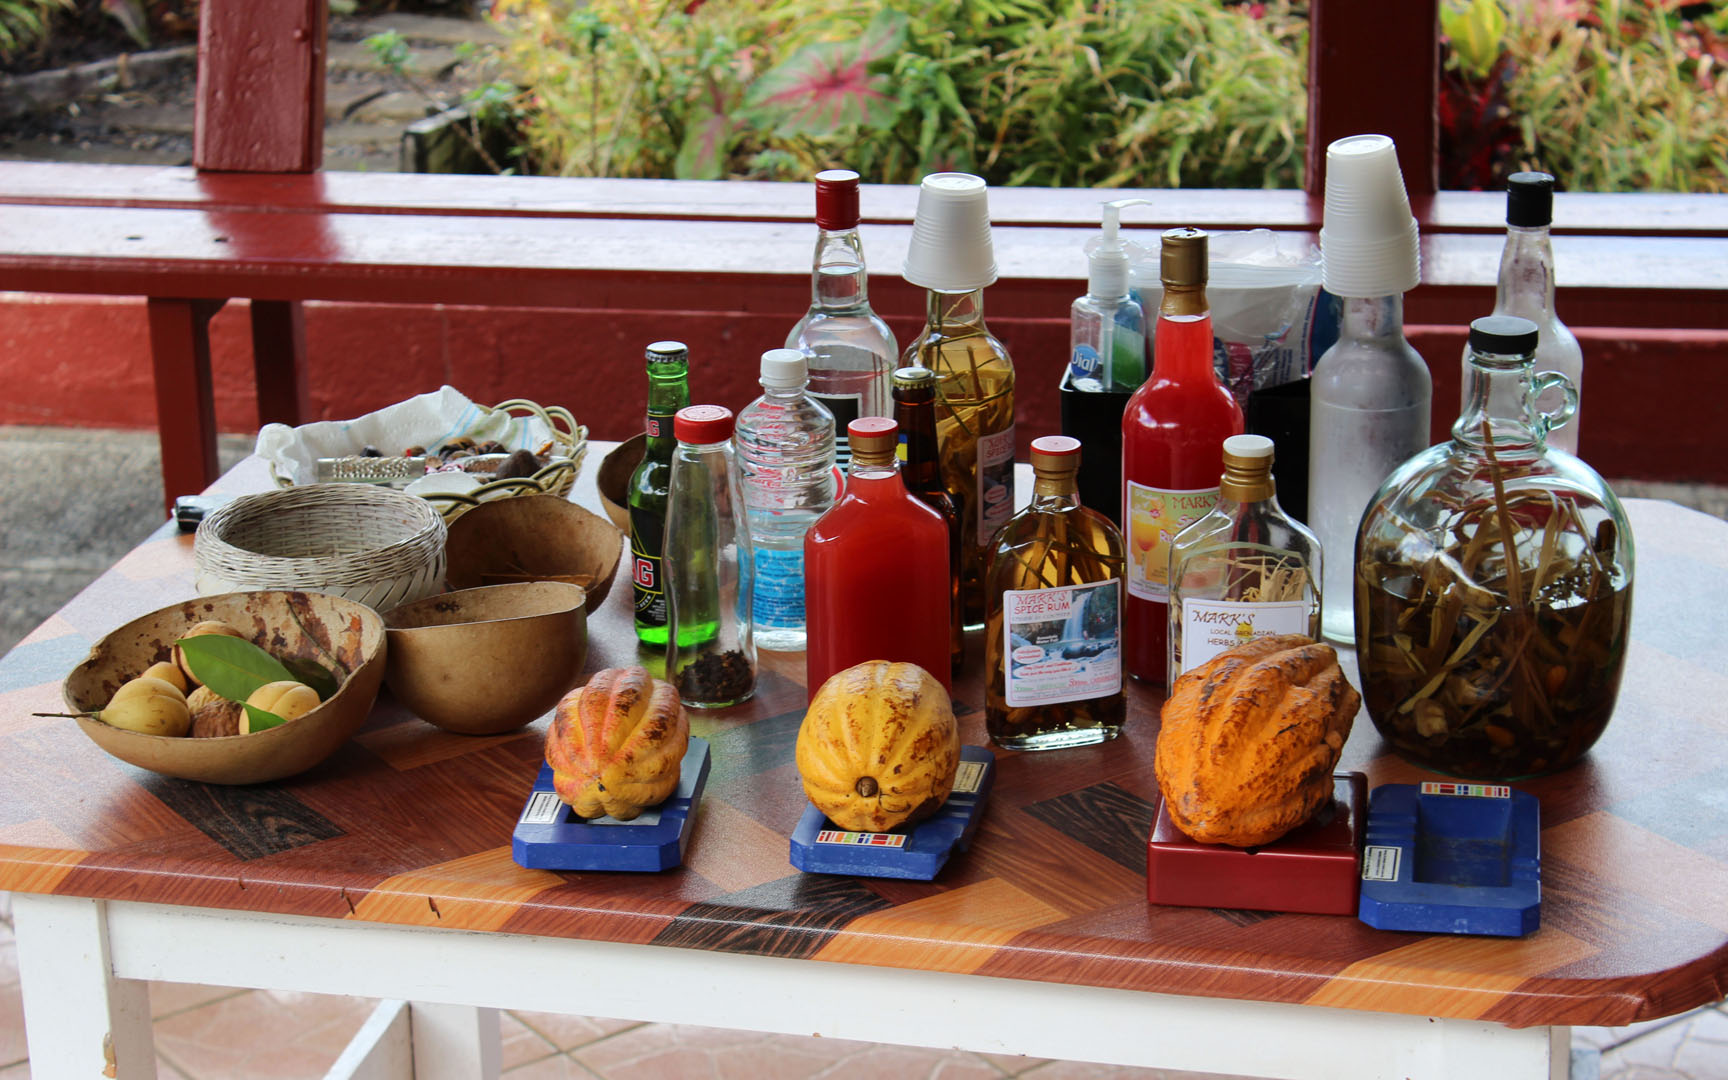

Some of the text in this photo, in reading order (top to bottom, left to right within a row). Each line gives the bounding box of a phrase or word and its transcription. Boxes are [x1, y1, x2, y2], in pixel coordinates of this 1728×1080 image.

[1072, 348, 1096, 372] Dial
[1014, 601, 1070, 615] SPICE RUM
[1192, 609, 1256, 626] MARK'S
[1210, 628, 1232, 636] LOCAL
[1208, 638, 1235, 647] HERBS
